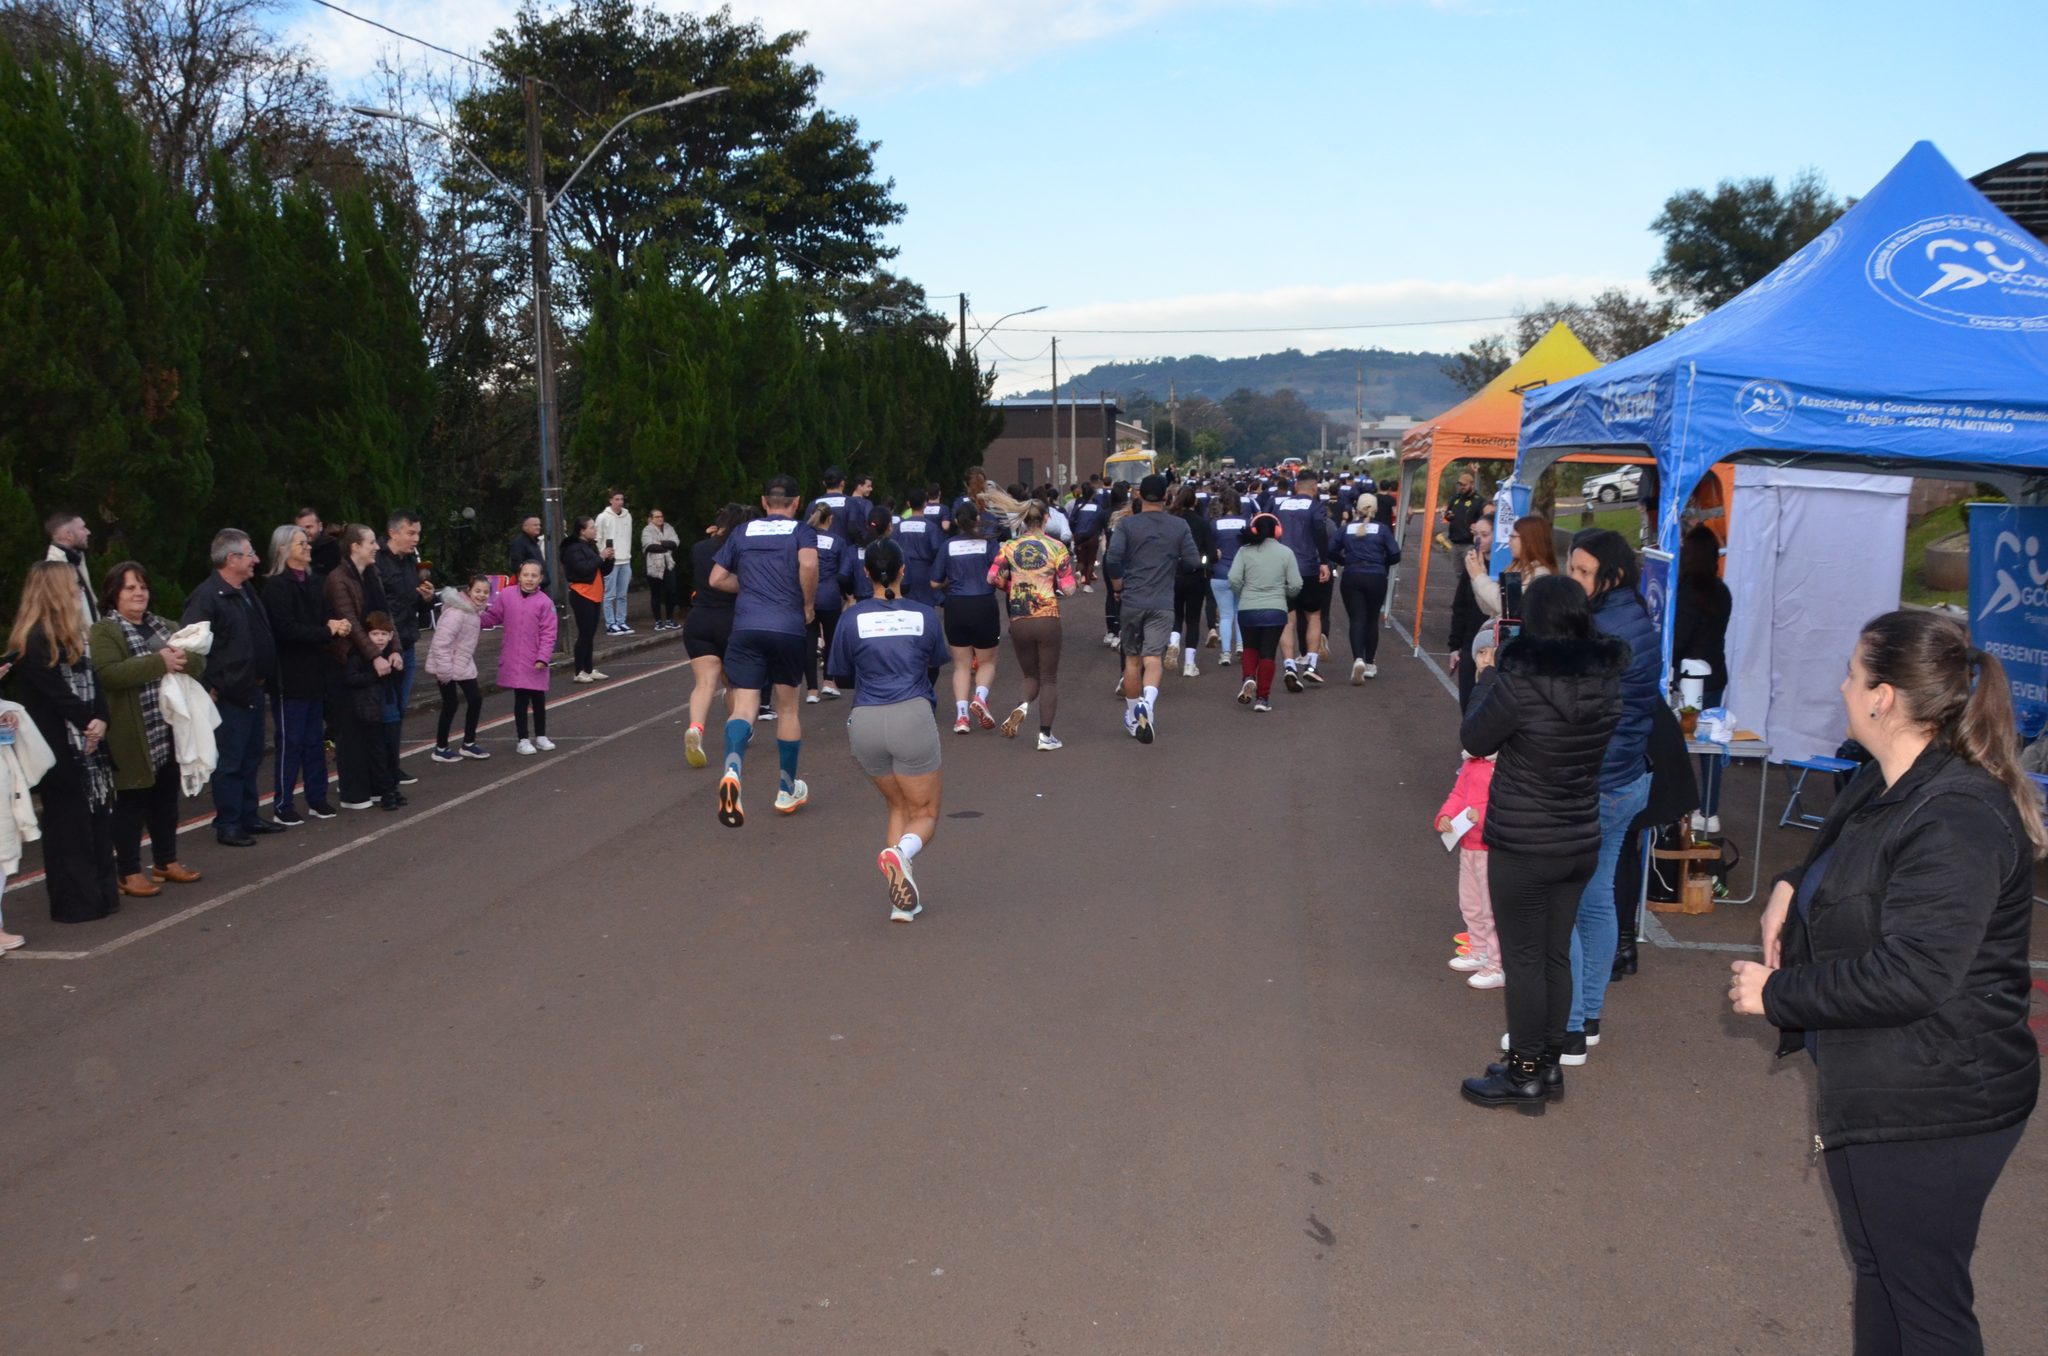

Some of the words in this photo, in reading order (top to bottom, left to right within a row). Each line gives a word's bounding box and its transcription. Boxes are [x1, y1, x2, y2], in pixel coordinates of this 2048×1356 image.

[1798, 395, 1864, 412] Associação
[1864, 401, 1880, 411] de
[1882, 401, 1946, 416] Corredores
[1946, 405, 1962, 417] de
[1962, 406, 1987, 418] Rua
[1987, 408, 2004, 419] de
[1904, 416, 1941, 429] GCOR
[1940, 419, 2015, 434] PALMITINHO
